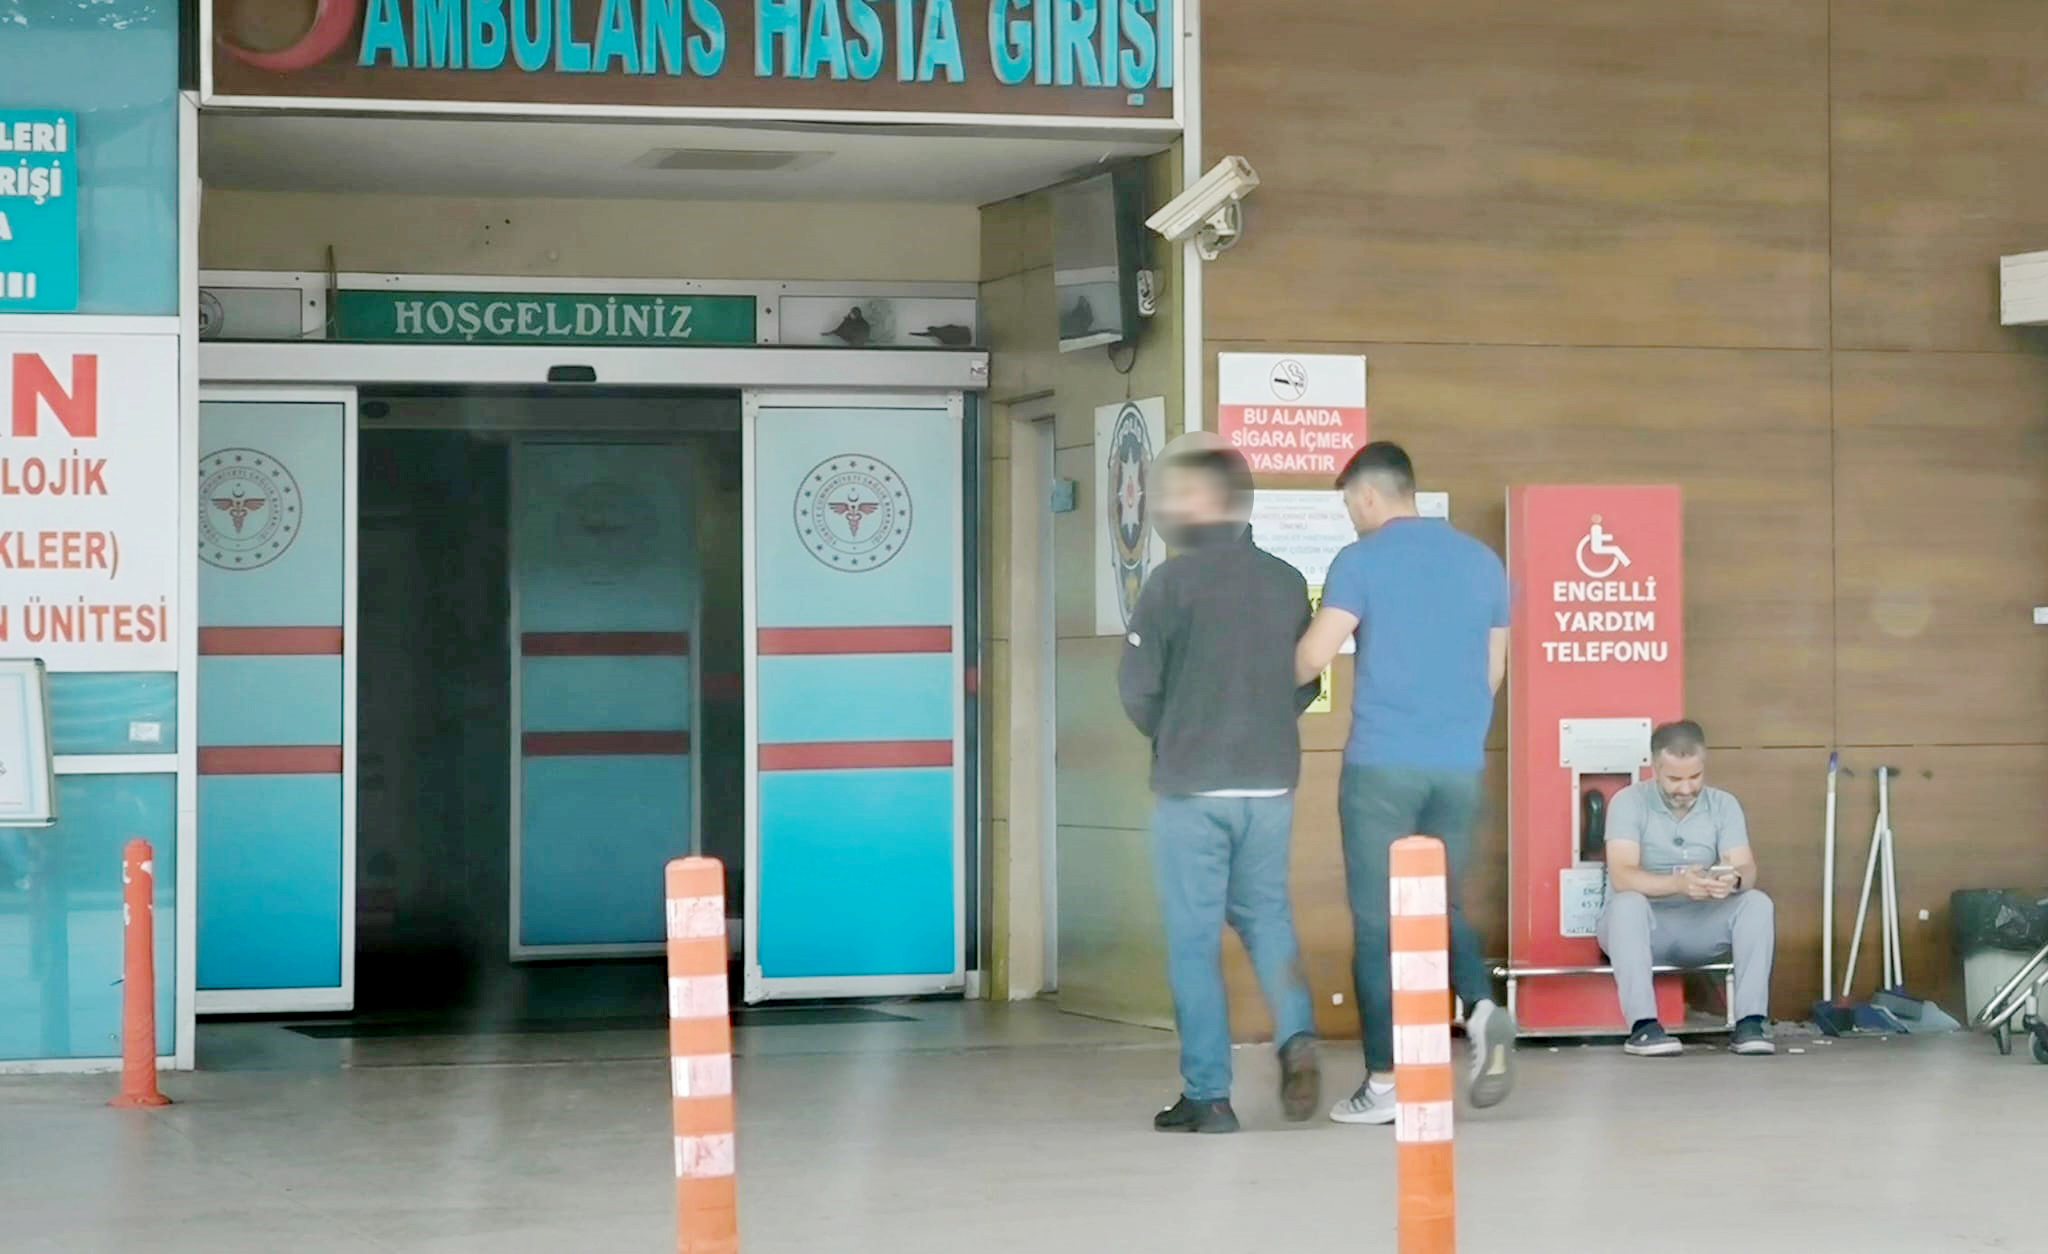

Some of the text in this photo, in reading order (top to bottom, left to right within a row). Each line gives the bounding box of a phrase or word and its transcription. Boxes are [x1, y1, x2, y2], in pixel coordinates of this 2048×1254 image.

[358, 0, 726, 76] AMBULANS
[0, 117, 67, 152] LERİ
[394, 296, 693, 342] HOŞGELDİNİZ
[1243, 408, 1342, 428] BU ALANDA
[1231, 428, 1355, 452] SİGARA İÇMEK
[2, 448, 108, 496] LOJİK
[1251, 453, 1335, 471] YASAKTIR
[1552, 575, 1658, 603] ENGELLİ
[23, 594, 168, 643] ÜNİTESİ
[1554, 611, 1656, 633] YARDIM
[1542, 641, 1669, 663] TELEFONU
